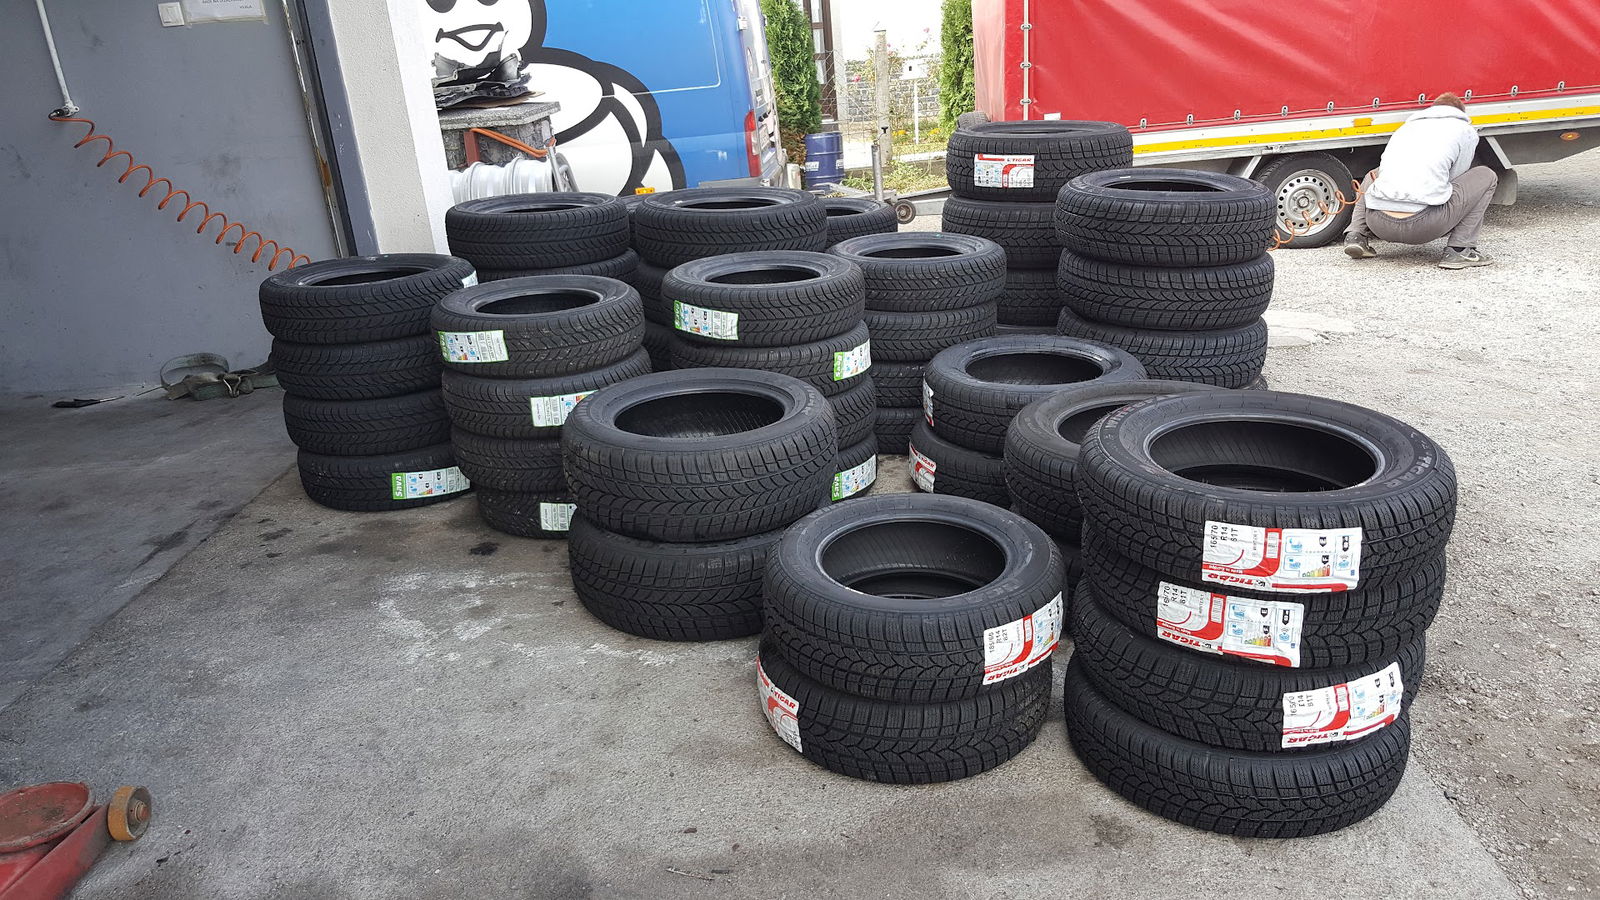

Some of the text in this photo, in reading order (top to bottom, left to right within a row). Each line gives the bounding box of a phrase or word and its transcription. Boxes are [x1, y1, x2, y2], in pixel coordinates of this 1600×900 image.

[1210, 525, 1219, 548] 165/70
[1220, 526, 1229, 542] R14
[1207, 572, 1254, 585] TIGAR
[1171, 588, 1179, 602] R14
[1161, 631, 1200, 647] TIGAR
[987, 667, 1018, 681] TIGAR
[774, 691, 796, 709] TIGAR
[1287, 733, 1328, 743] TIGAR
